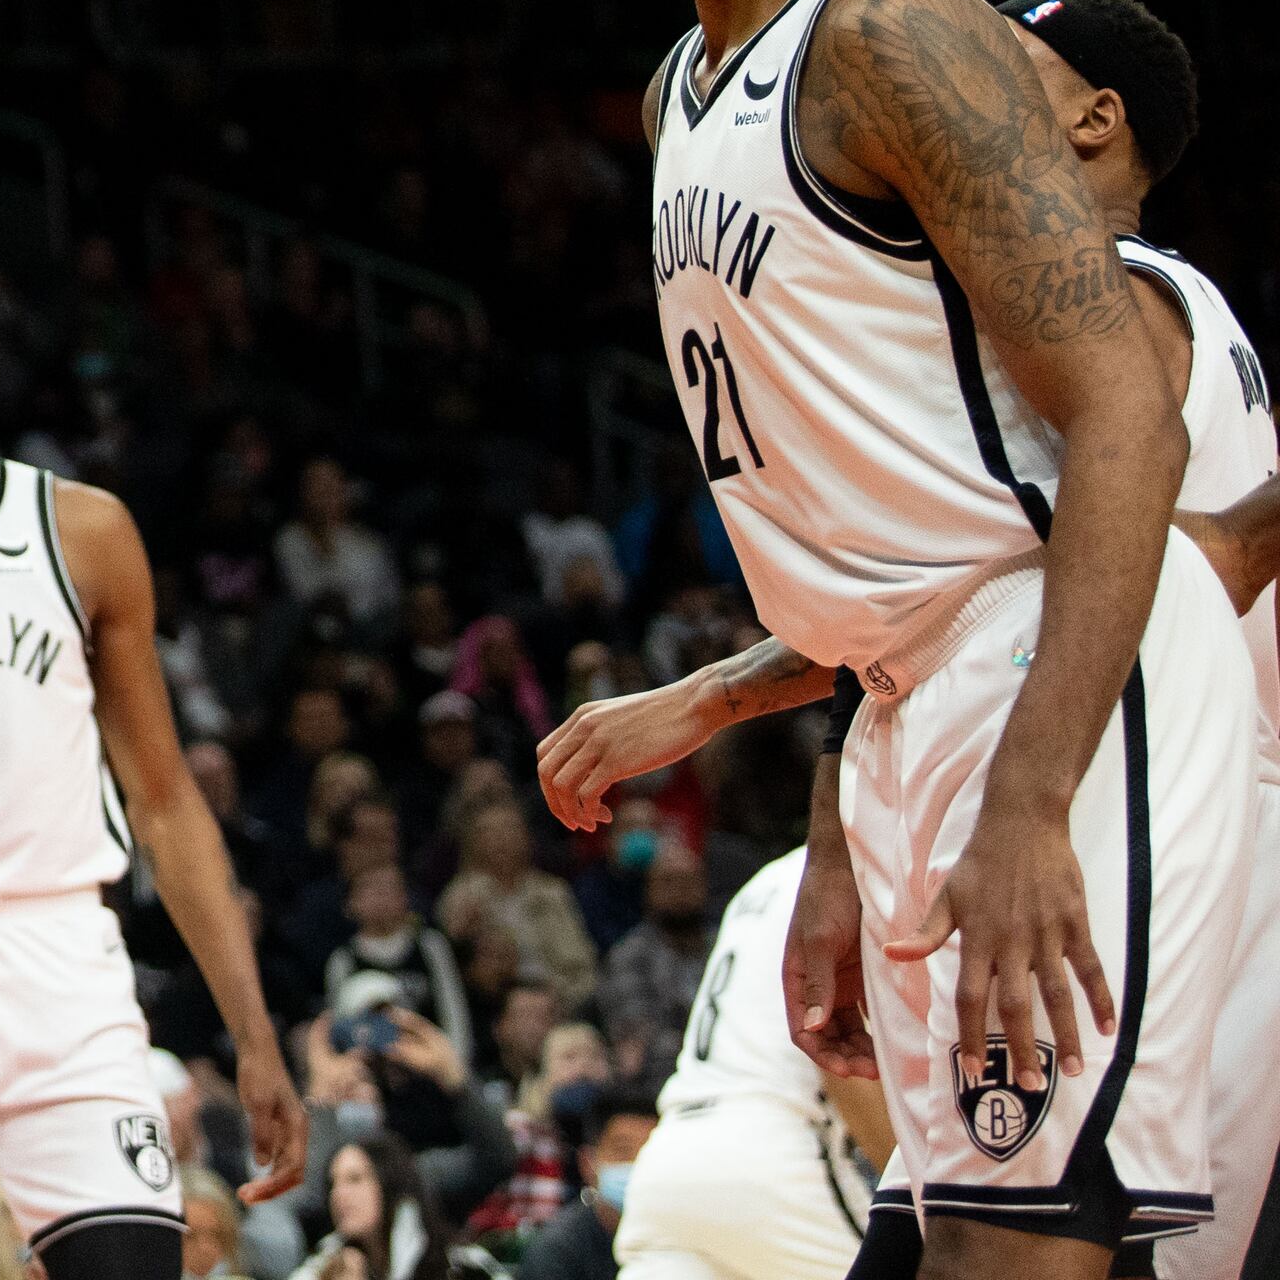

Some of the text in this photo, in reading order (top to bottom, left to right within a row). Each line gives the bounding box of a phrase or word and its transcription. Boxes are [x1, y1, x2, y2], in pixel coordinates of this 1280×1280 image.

[734, 107, 770, 127] Webull
[653, 185, 776, 300] OOKLYN
[682, 322, 766, 482] 21
[990, 1097, 1007, 1140] B
